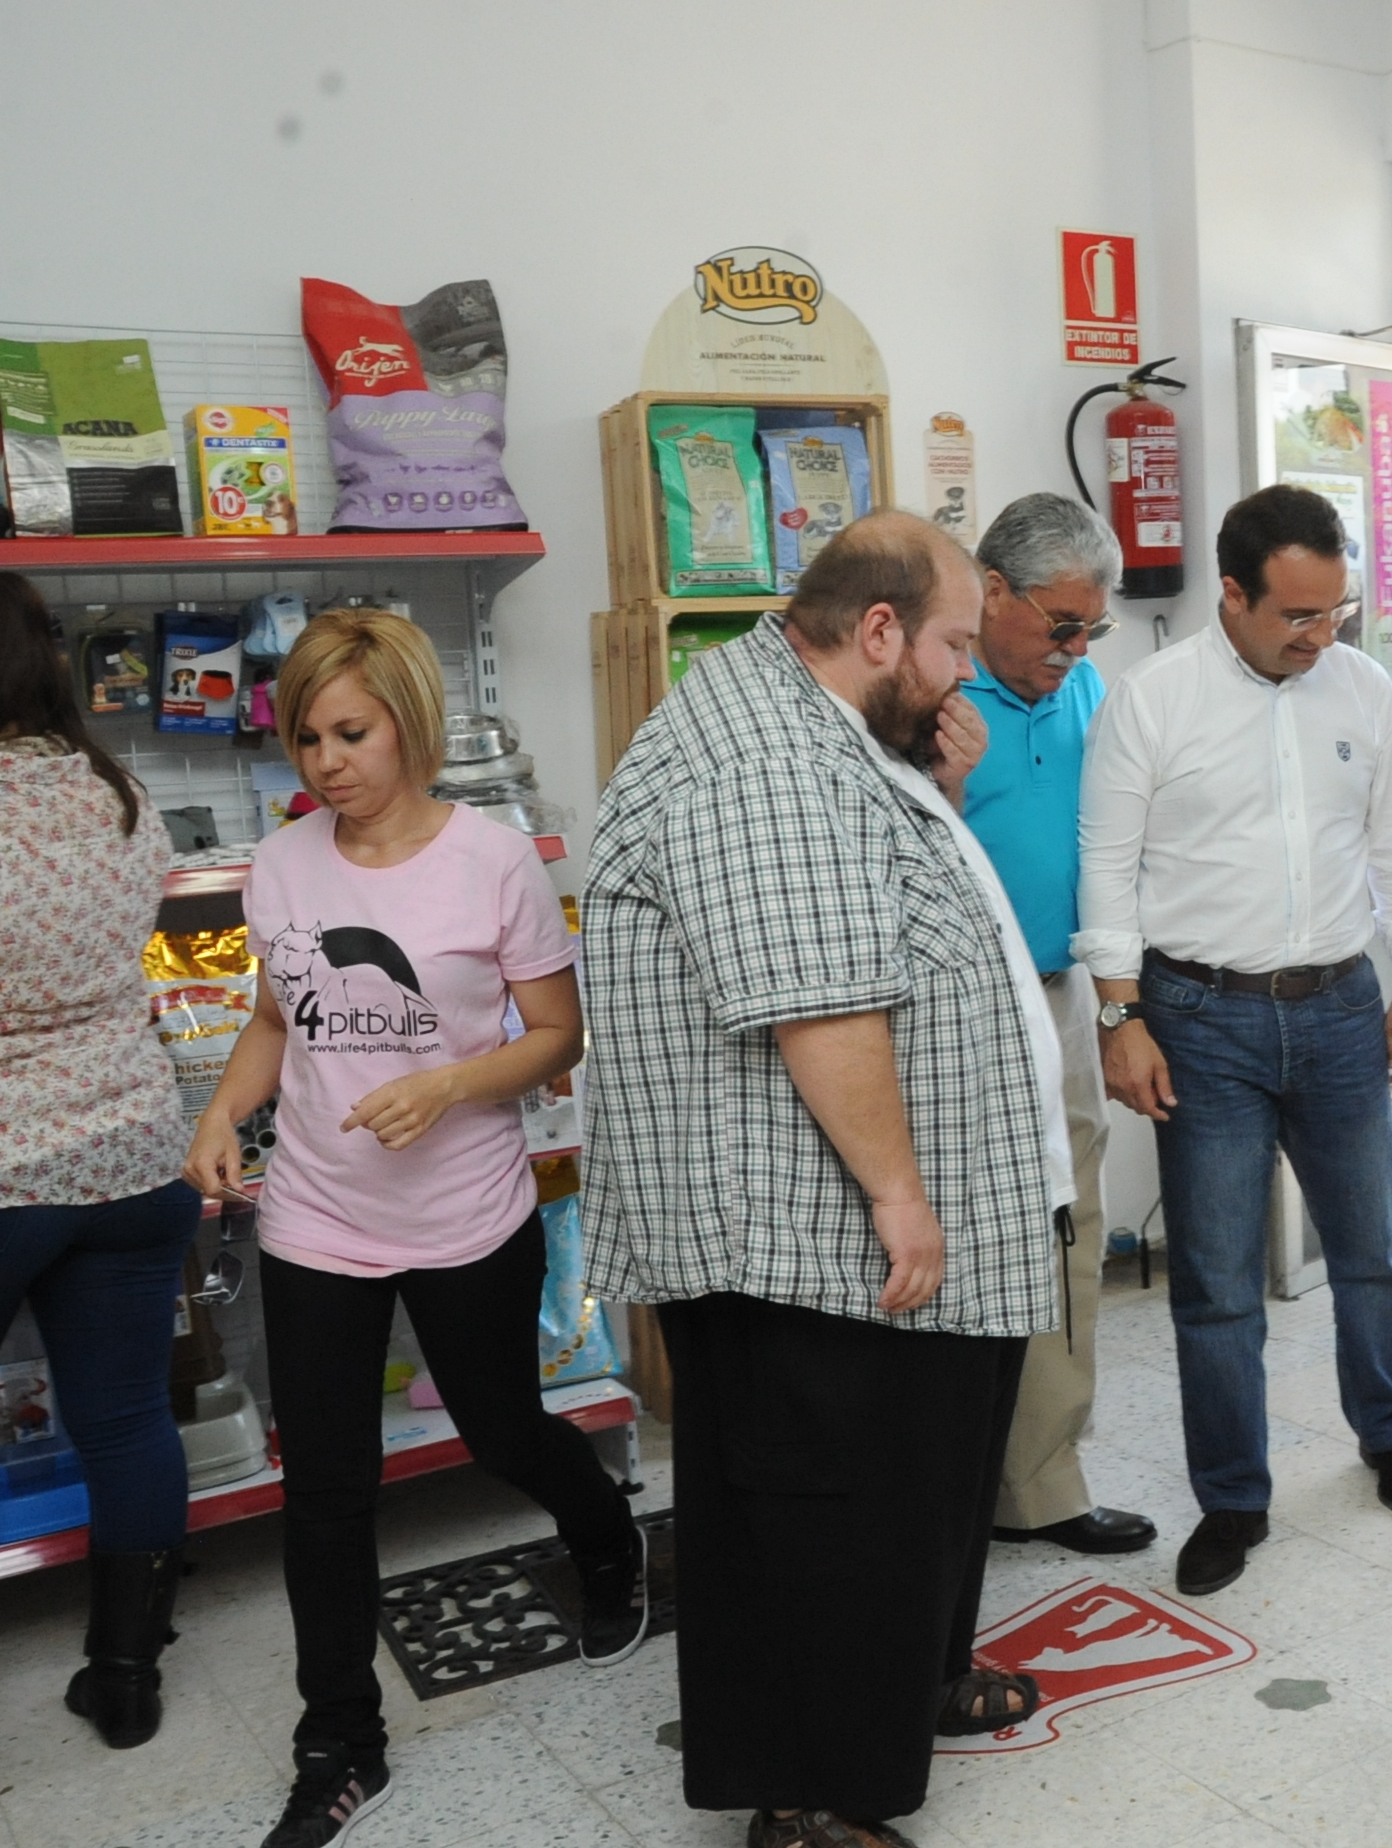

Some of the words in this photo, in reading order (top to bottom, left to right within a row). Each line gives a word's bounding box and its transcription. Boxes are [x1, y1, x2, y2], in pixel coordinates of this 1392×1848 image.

[695, 257, 818, 324] Nutro
[1066, 328, 1119, 343] EXTINTOR
[1123, 332, 1138, 345] DE
[700, 352, 776, 362] ALIMENTACIÓN
[780, 354, 826, 363] NATURAL
[1074, 346, 1131, 360] INCENDIOS
[335, 350, 410, 388] Orijen
[355, 409, 436, 430] Puppy
[62, 419, 139, 436] ACANA
[221, 438, 280, 448] DENTASTIX
[791, 447, 842, 461] NATURAL
[797, 459, 838, 473] CHOICE
[171, 648, 197, 657] TRIXIE
[307, 1042, 441, 1055] www.life4pitbulls.com
